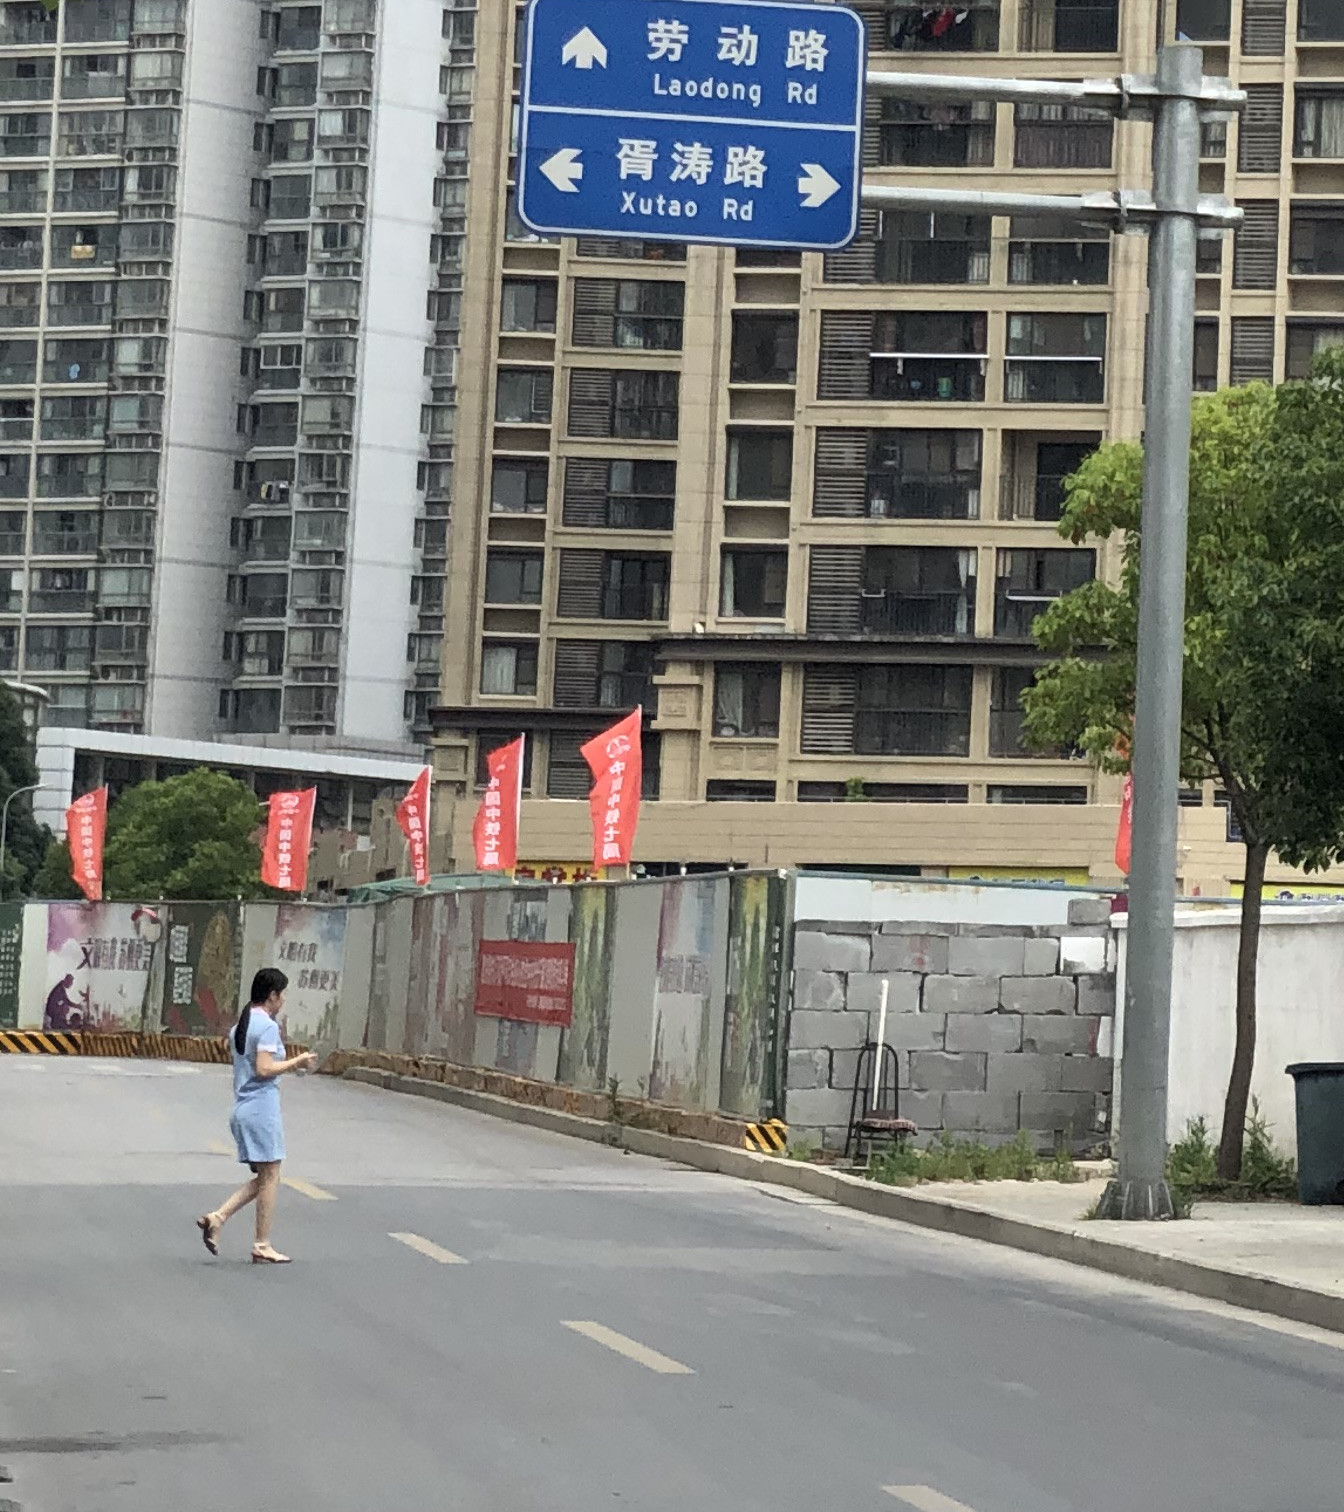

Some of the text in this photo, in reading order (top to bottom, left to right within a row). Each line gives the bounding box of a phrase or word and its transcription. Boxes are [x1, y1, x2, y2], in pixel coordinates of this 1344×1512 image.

[647, 18, 828, 72] 劳动路
[653, 73, 818, 107] Laodong Rd
[616, 137, 768, 189] 胥涛路
[620, 191, 753, 221] Xutao Rd
